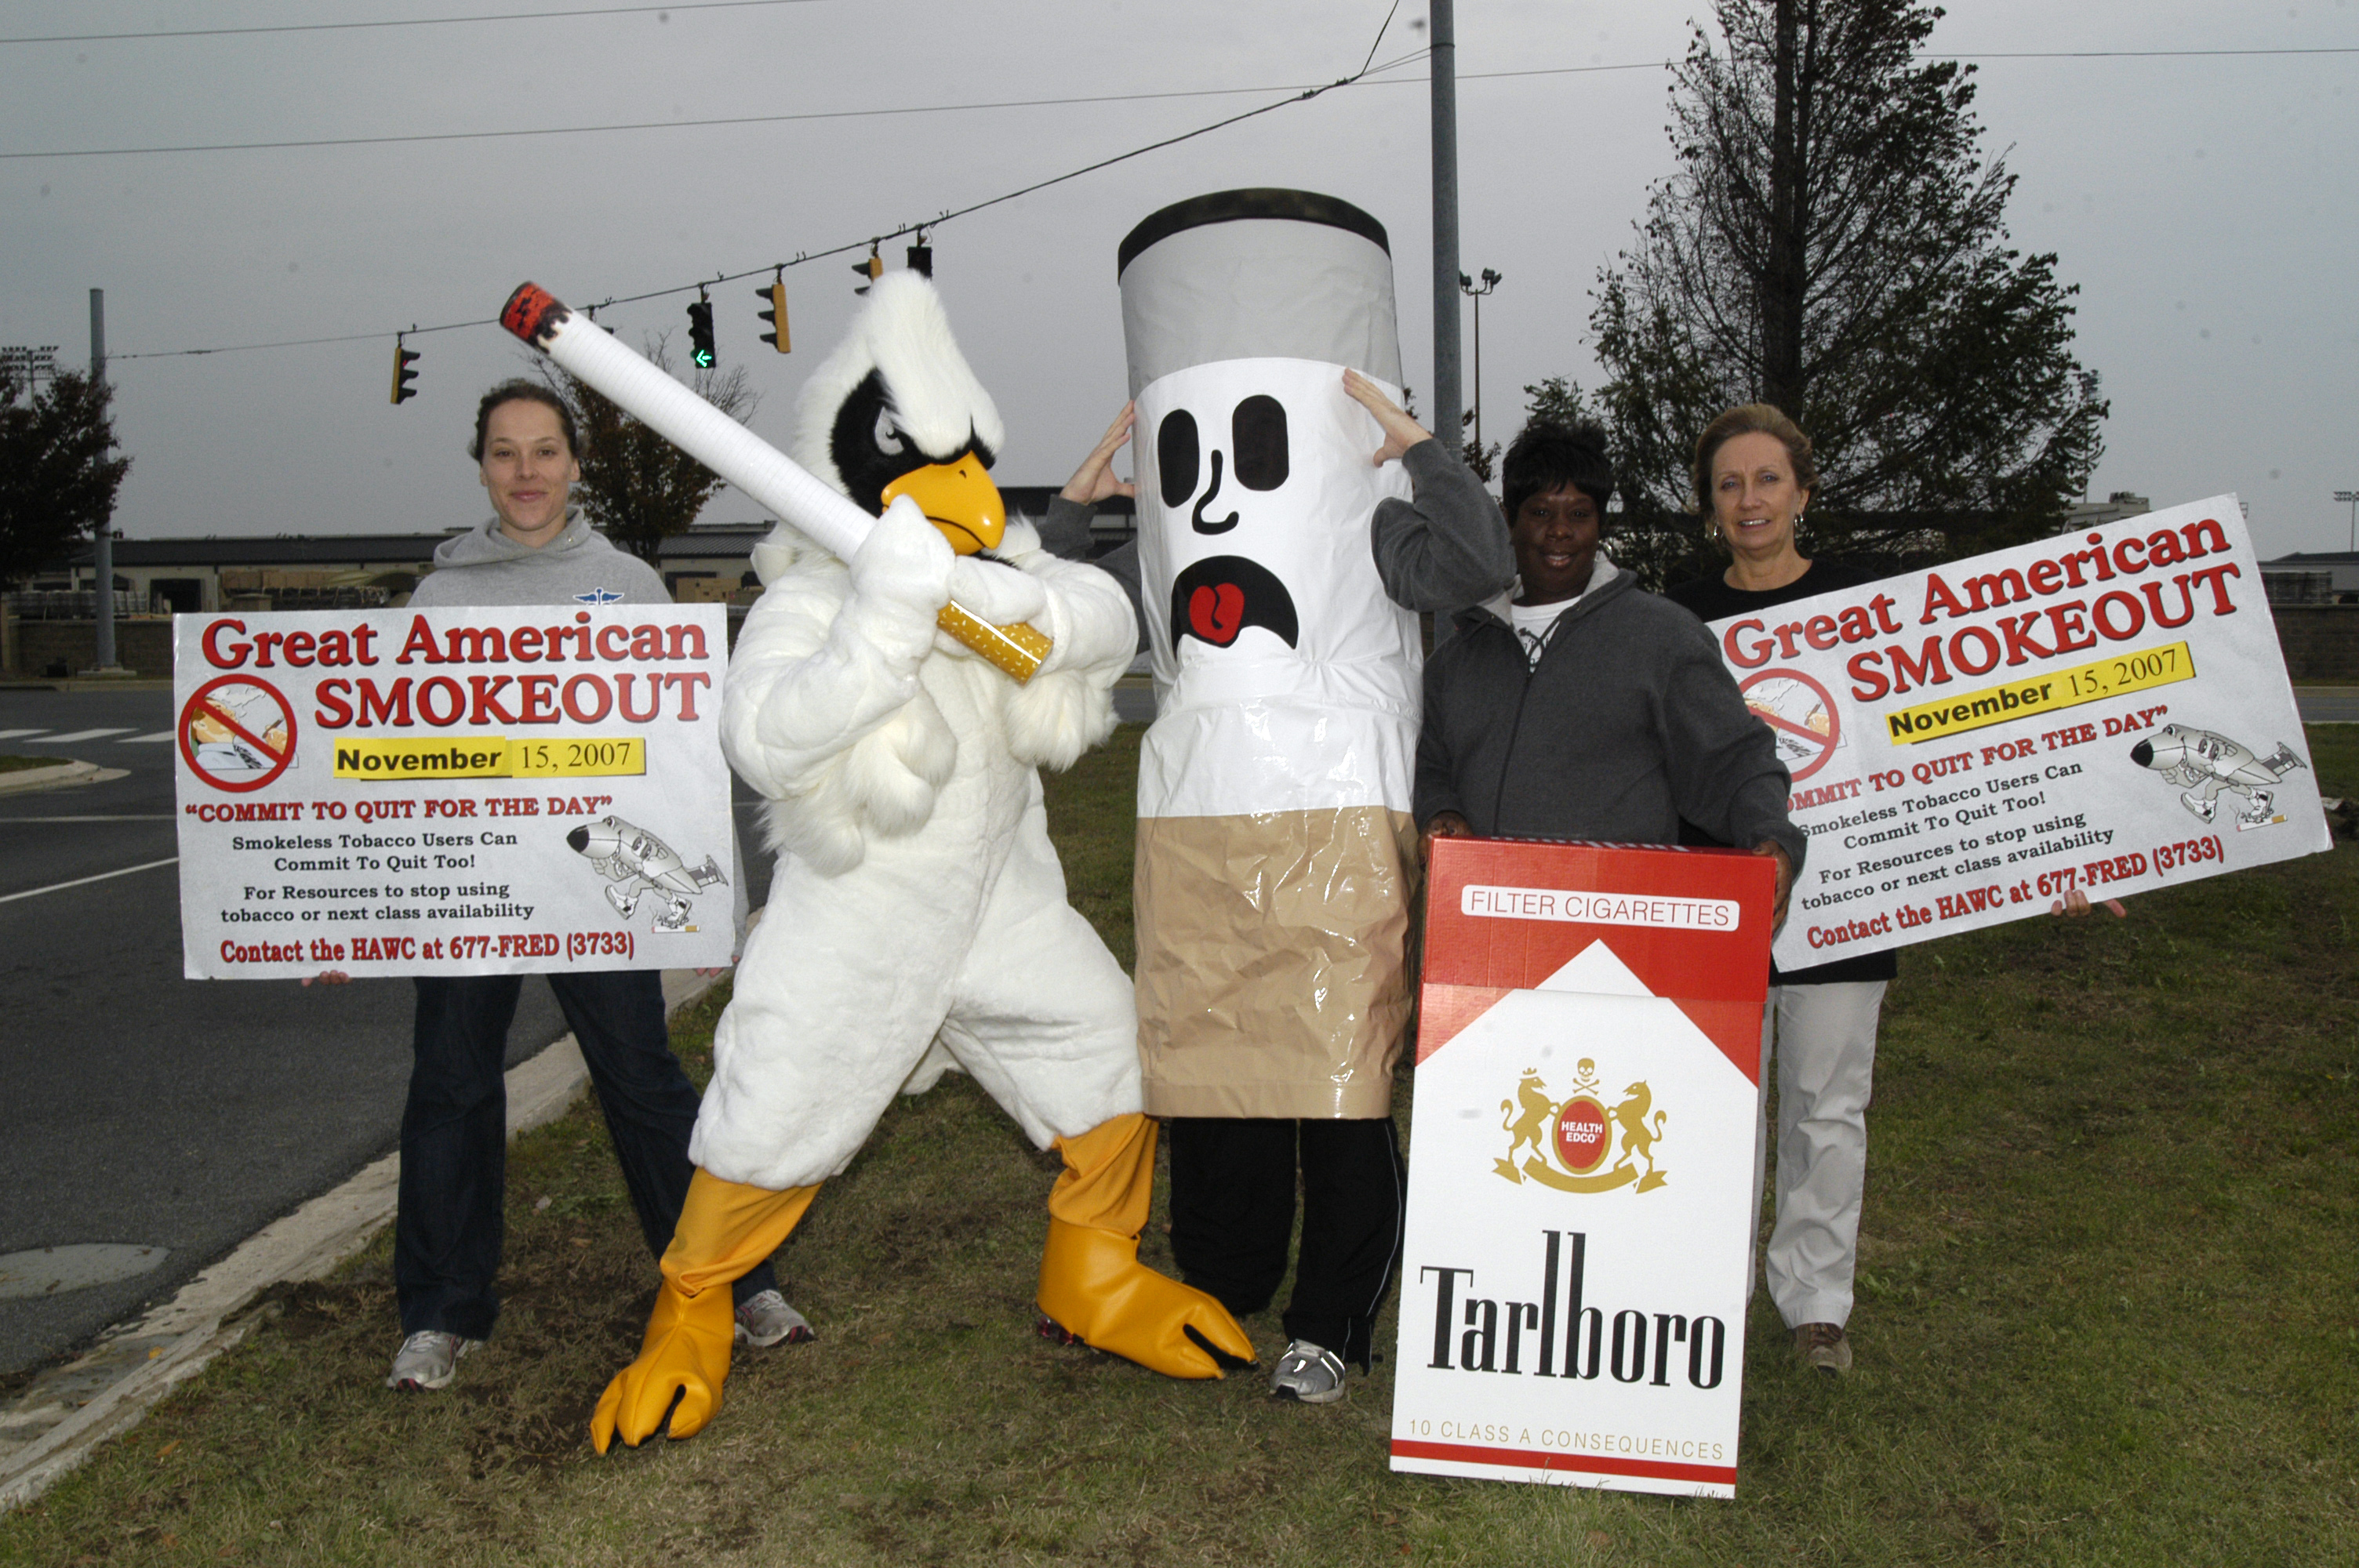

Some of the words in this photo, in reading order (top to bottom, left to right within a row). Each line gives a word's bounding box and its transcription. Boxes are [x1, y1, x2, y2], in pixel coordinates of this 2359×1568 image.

[1723, 593, 1903, 669] Great
[1918, 518, 2233, 625] American
[201, 618, 380, 670] Great
[394, 611, 710, 666] American
[1846, 561, 2241, 703] SMOKEOUT
[314, 672, 711, 730] SMOKEOUT
[1888, 683, 2052, 738] November
[2069, 669, 2109, 697] 15,
[2114, 648, 2175, 686] 2007
[337, 747, 502, 771] November
[523, 745, 559, 772] 15,
[568, 742, 631, 768] 2007
[1868, 769, 1906, 793] TO
[1911, 751, 1974, 786] QUIT
[1979, 738, 2038, 767] FOR
[2041, 723, 2097, 751] THE
[2103, 706, 2168, 737] DAY”
[185, 801, 305, 823] “COMMIT
[311, 800, 347, 821] TO
[354, 799, 416, 824] QUIT
[423, 799, 478, 818] FOR
[484, 797, 540, 817] THE
[547, 795, 612, 816] DAY”
[1799, 807, 1898, 838] Smokeless
[1901, 787, 1981, 814] Tobacco
[1985, 773, 2040, 793] Users
[2044, 763, 2083, 780] Can
[1843, 821, 1921, 849] Commit
[1924, 815, 1950, 831] To
[1955, 803, 1998, 826] Quit
[2001, 790, 2046, 812] Too!
[232, 834, 333, 851] Smokeless
[338, 833, 416, 848] Tobacco
[422, 833, 474, 848] Users
[480, 831, 518, 846] Can
[274, 856, 351, 872] Commit
[356, 855, 380, 870] To
[386, 855, 428, 873] Quit
[433, 854, 475, 869] Too!
[1801, 885, 1875, 910] tobacco
[1881, 879, 1900, 892] or
[1906, 866, 1950, 887] next
[1954, 855, 2001, 875] class
[2007, 829, 2114, 863] availability
[1819, 868, 1852, 884] For
[1856, 844, 1954, 876] Resources
[1958, 838, 1979, 851] to
[1985, 827, 2026, 846] stop
[2032, 813, 2087, 835] using
[220, 908, 295, 923] tobacco
[301, 910, 322, 921] or
[327, 906, 369, 920] next
[375, 905, 421, 920] class
[427, 902, 535, 920] availability
[244, 886, 276, 900] For
[282, 885, 379, 900] Resources
[384, 884, 404, 898] to
[410, 884, 451, 901] stop
[456, 881, 511, 899] using
[1471, 891, 1555, 916] FILTER
[1565, 896, 1729, 927] CIGARETTES
[1806, 912, 1892, 949] Contact
[1896, 904, 1933, 930] the
[1935, 884, 2005, 920] HAWC
[2008, 879, 2034, 904] at
[2037, 852, 2148, 897] 677-FRED
[2152, 834, 2224, 877] (3733)
[220, 939, 304, 964] Contact
[310, 937, 345, 962] the
[351, 936, 416, 961] HAWC
[422, 937, 444, 960] at
[449, 933, 560, 960] 677-FRED
[566, 931, 634, 963] (3733)
[1561, 1120, 1603, 1134] HEALTH
[1419, 1229, 1725, 1390] Tarlboro
[1409, 1419, 1430, 1436] 10
[1441, 1421, 1510, 1442] CLASS
[1519, 1428, 1531, 1444] A
[1541, 1429, 1724, 1460] CONSEQUENCES
